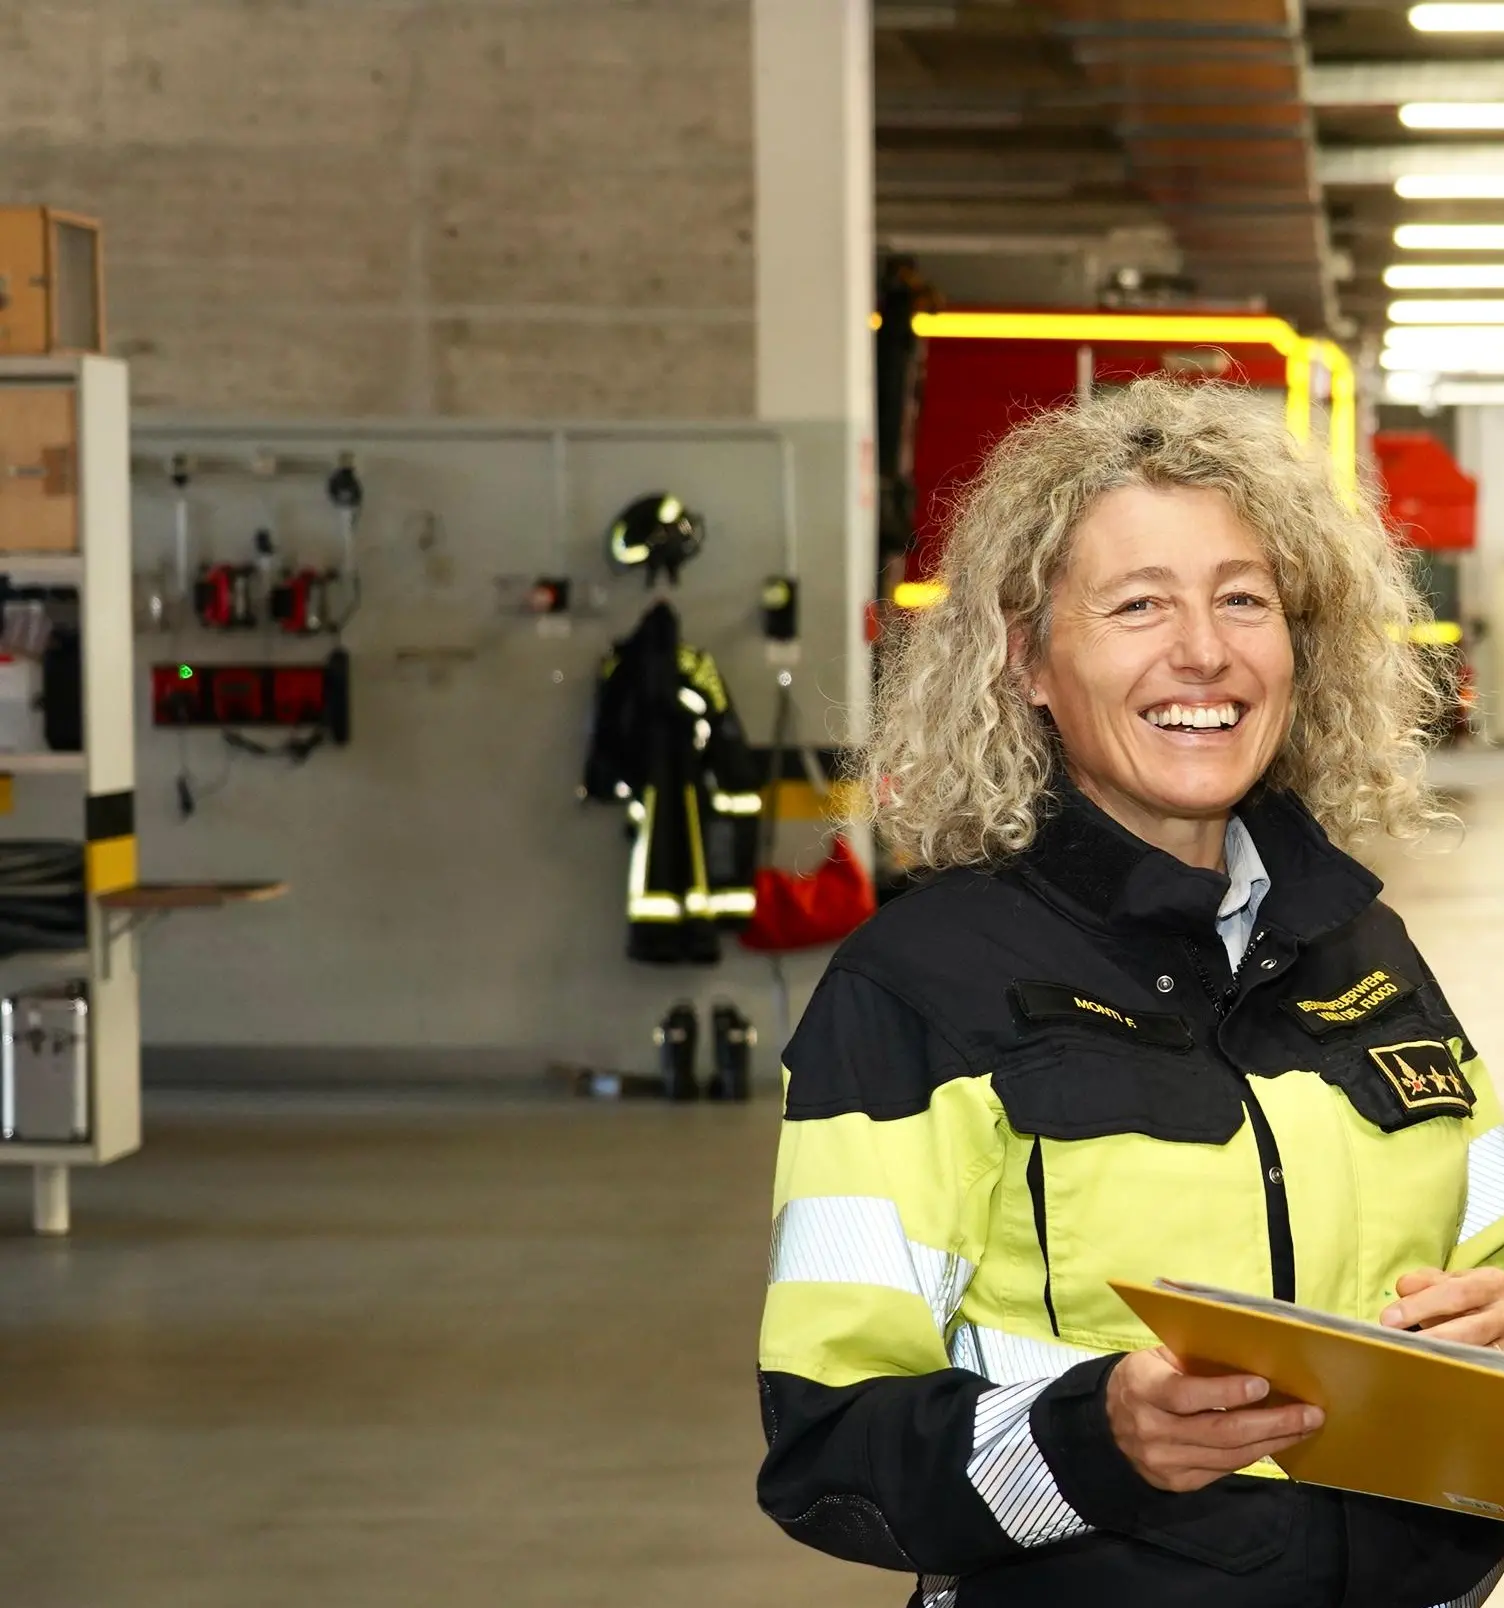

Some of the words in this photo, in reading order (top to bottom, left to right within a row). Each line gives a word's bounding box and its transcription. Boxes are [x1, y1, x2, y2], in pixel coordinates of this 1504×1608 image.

[1296, 971, 1390, 1012] BEFEUERWEHR
[1360, 983, 1398, 1010] FUOCO
[1073, 997, 1123, 1023] MONTI
